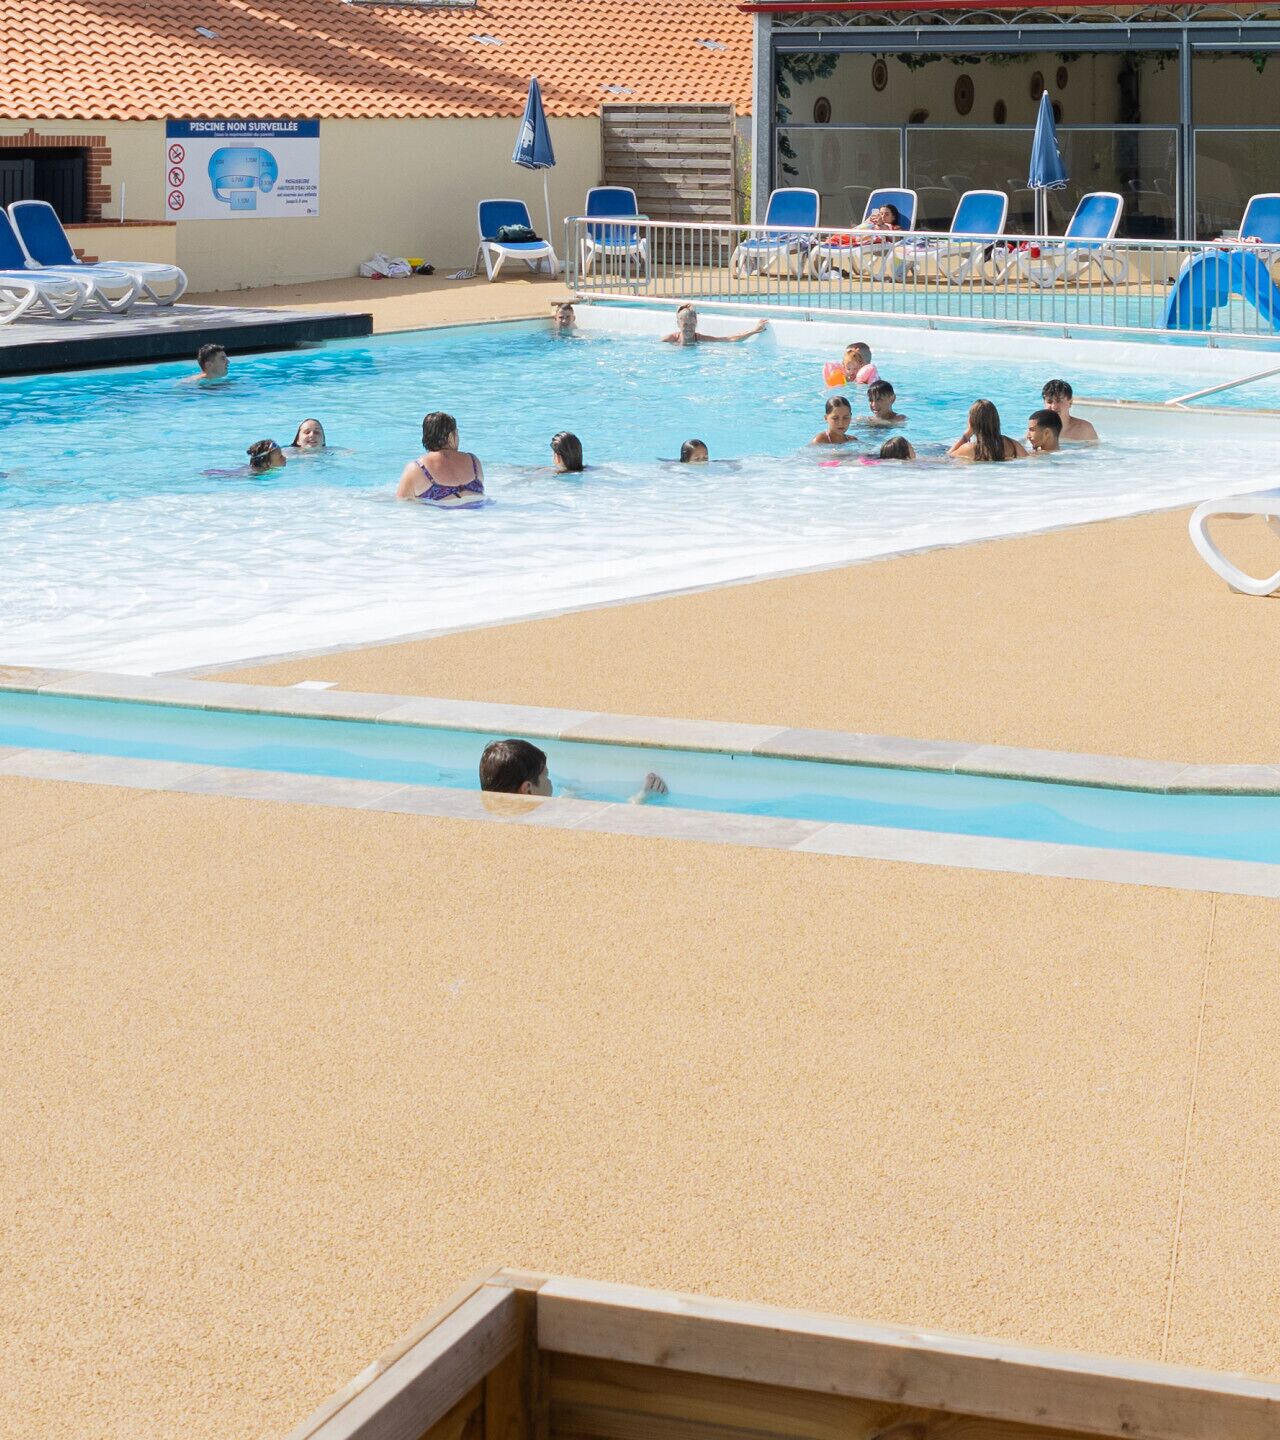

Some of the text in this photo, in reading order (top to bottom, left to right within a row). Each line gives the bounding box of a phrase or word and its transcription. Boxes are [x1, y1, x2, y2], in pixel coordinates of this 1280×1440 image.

[190, 121, 298, 131] PISCINE NON SURVEILLÉE
